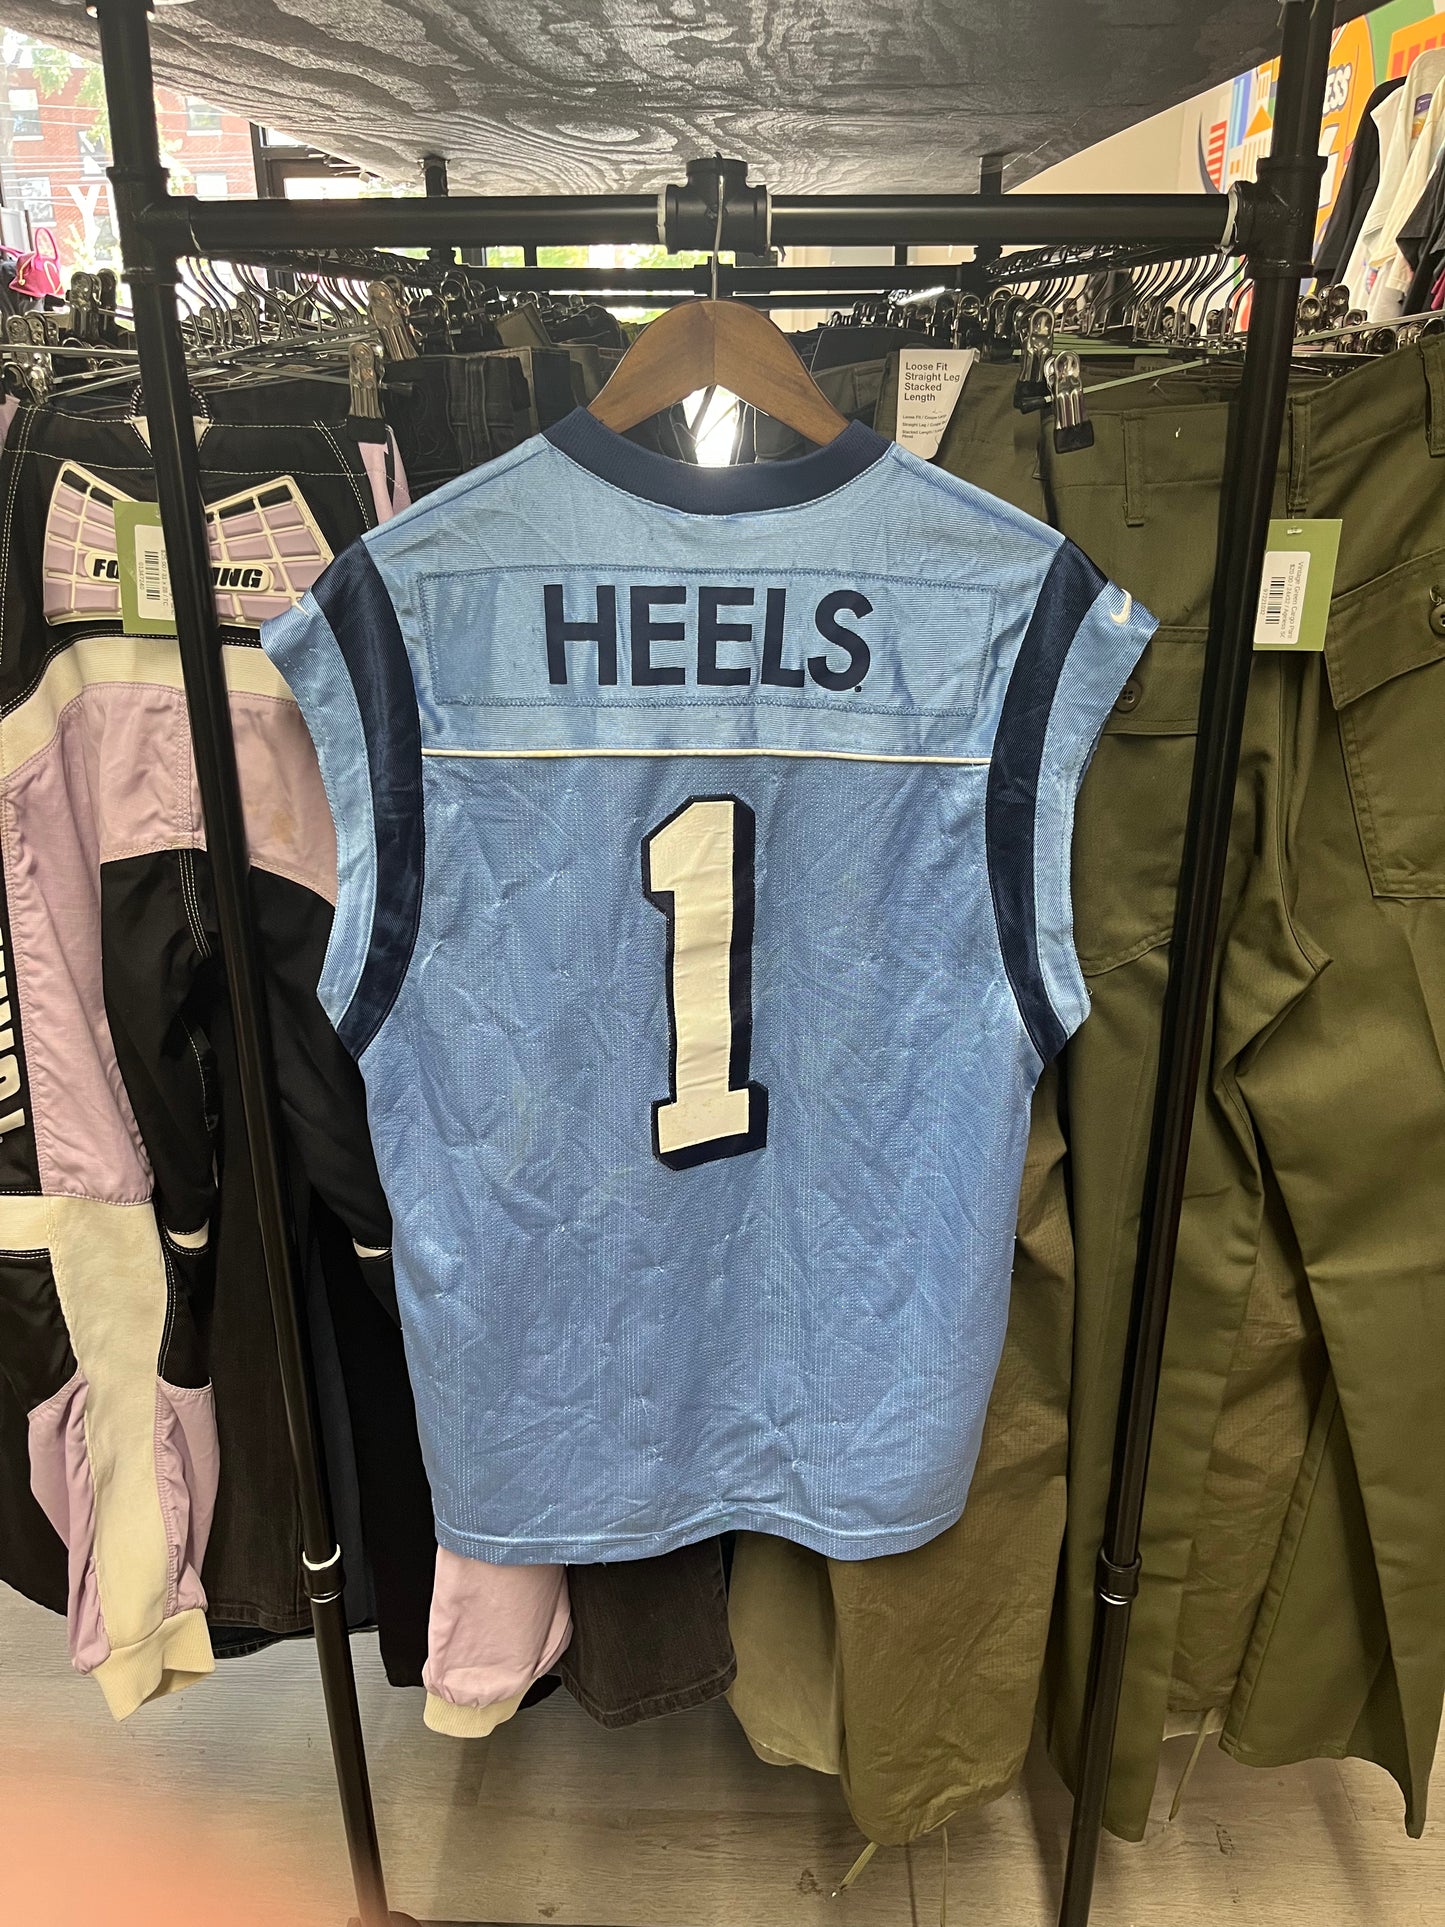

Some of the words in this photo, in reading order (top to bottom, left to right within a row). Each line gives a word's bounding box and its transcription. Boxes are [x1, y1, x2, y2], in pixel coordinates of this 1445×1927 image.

[905, 362, 934, 371] Loose
[936, 362, 948, 371] Fit
[905, 373, 941, 382] Straight
[943, 373, 960, 382] Leg
[905, 383, 942, 392] Stacked
[904, 393, 936, 403] Length
[93, 558, 119, 580] FO
[1295, 561, 1304, 584] Vintage
[1292, 586, 1301, 605] Green
[1289, 606, 1298, 625] Cargo
[543, 584, 874, 692] HEELS
[641, 794, 769, 1171] 1
